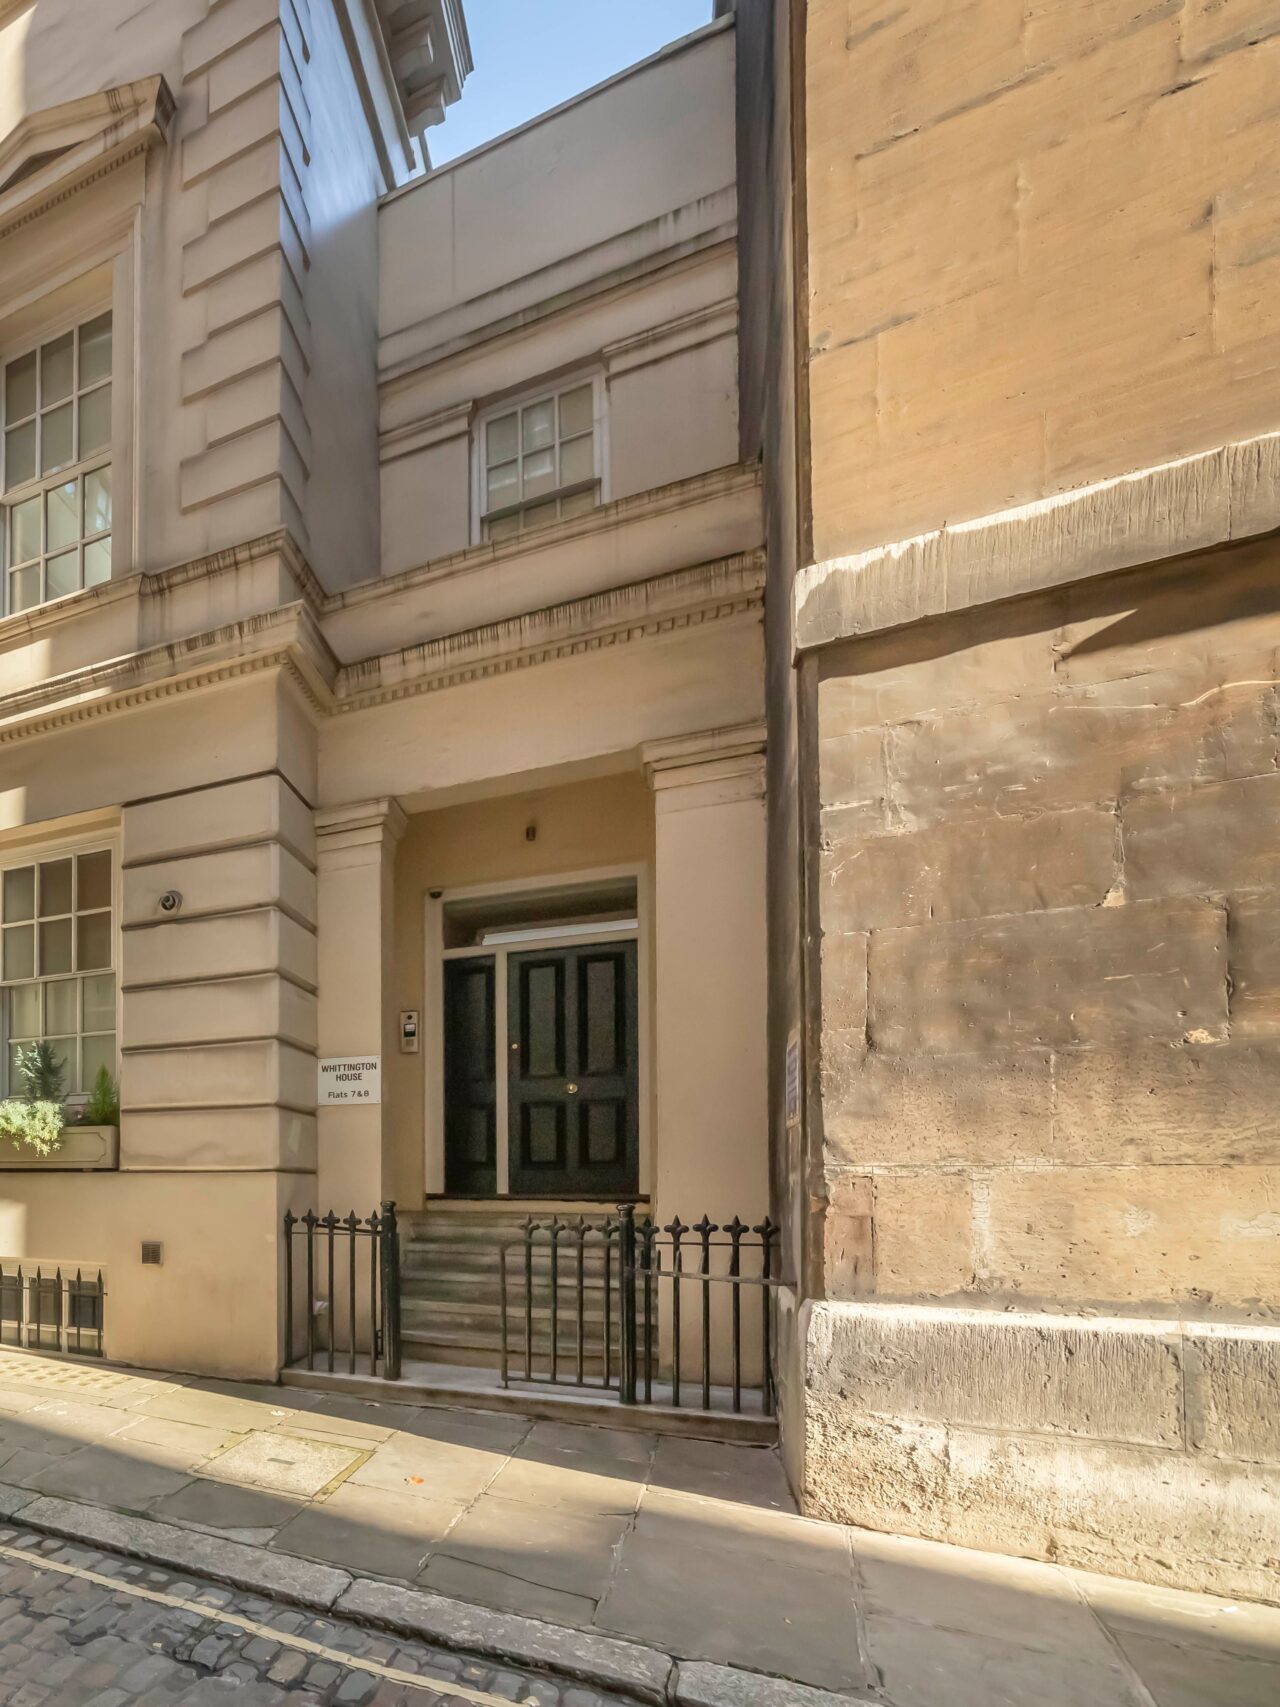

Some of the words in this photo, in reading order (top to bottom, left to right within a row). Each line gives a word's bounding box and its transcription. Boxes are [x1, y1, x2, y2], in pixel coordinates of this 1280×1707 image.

[321, 1062, 377, 1072] WHITTINGTON
[335, 1072, 363, 1081] HOUSE
[327, 1091, 348, 1099] Flats
